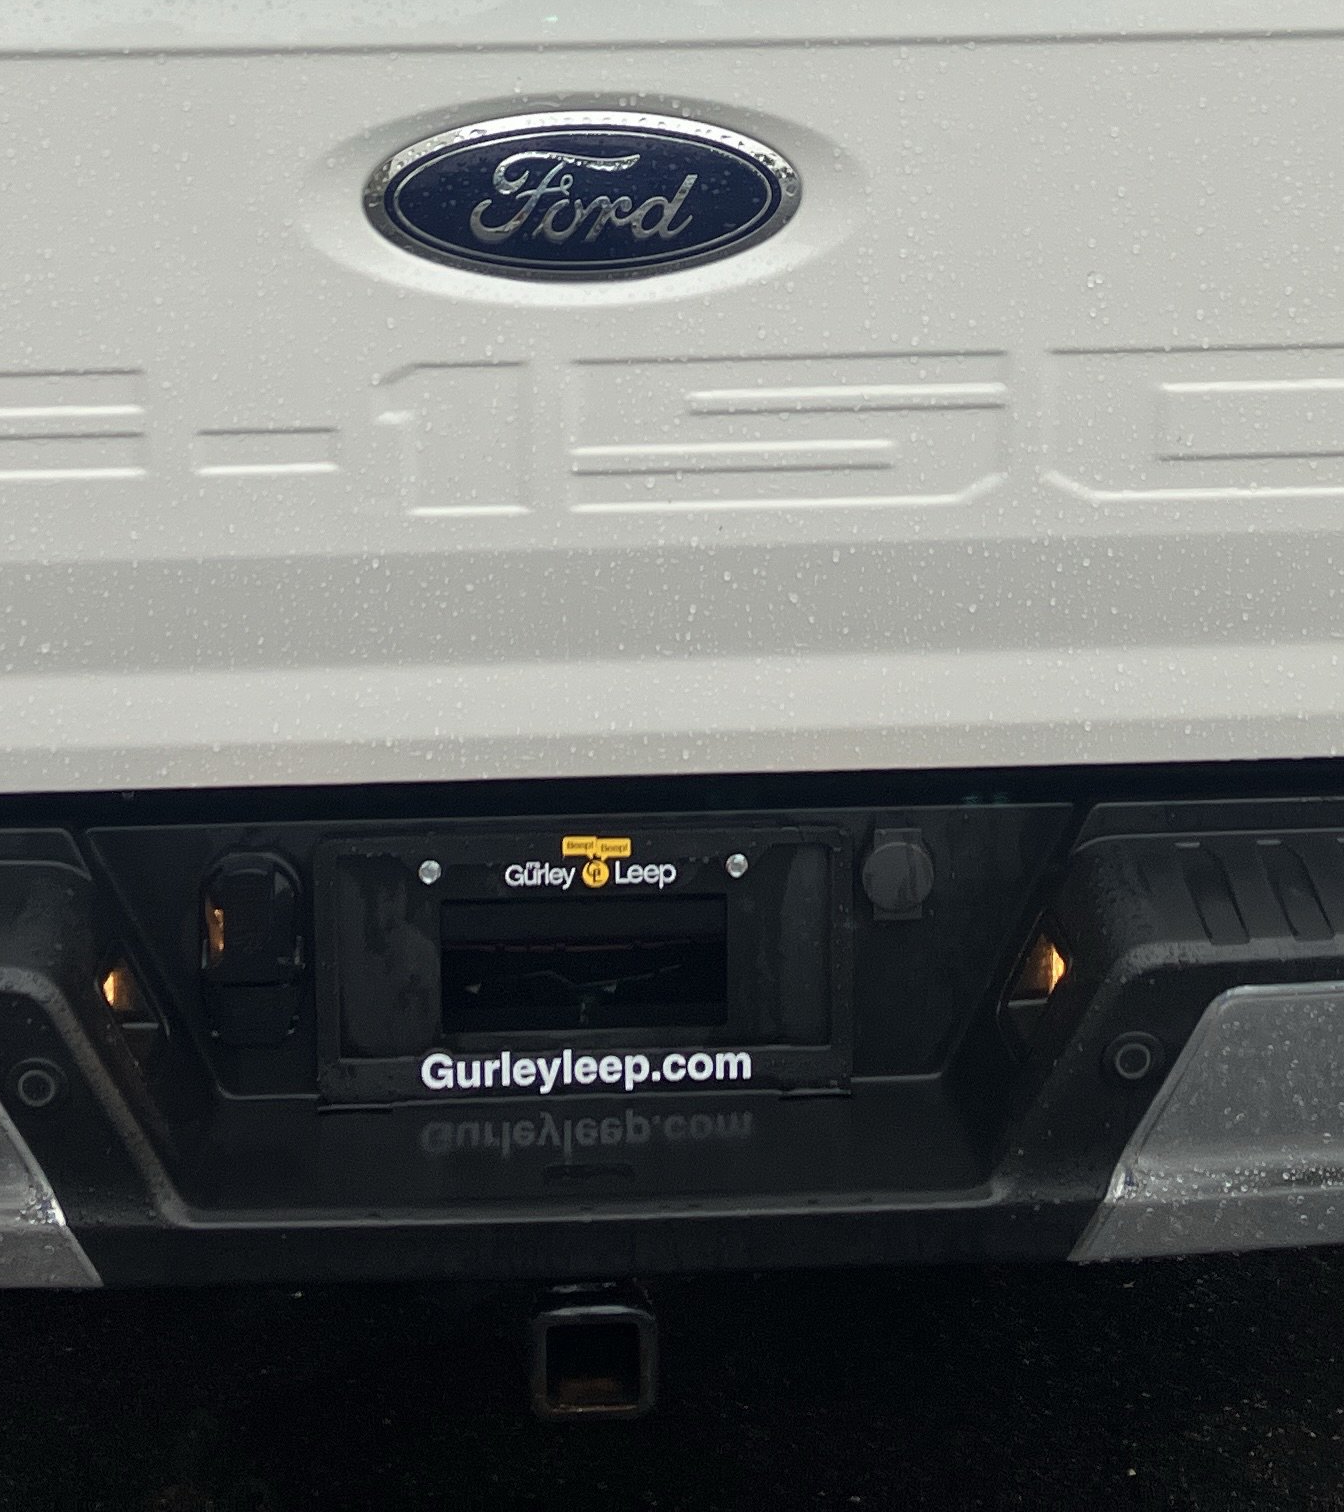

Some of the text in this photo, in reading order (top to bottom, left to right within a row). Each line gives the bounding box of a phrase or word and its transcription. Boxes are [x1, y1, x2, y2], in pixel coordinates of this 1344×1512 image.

[469, 150, 698, 245] Ford
[505, 861, 677, 891] Gurley Leep
[420, 1048, 753, 1095] Gurleyleep.com
